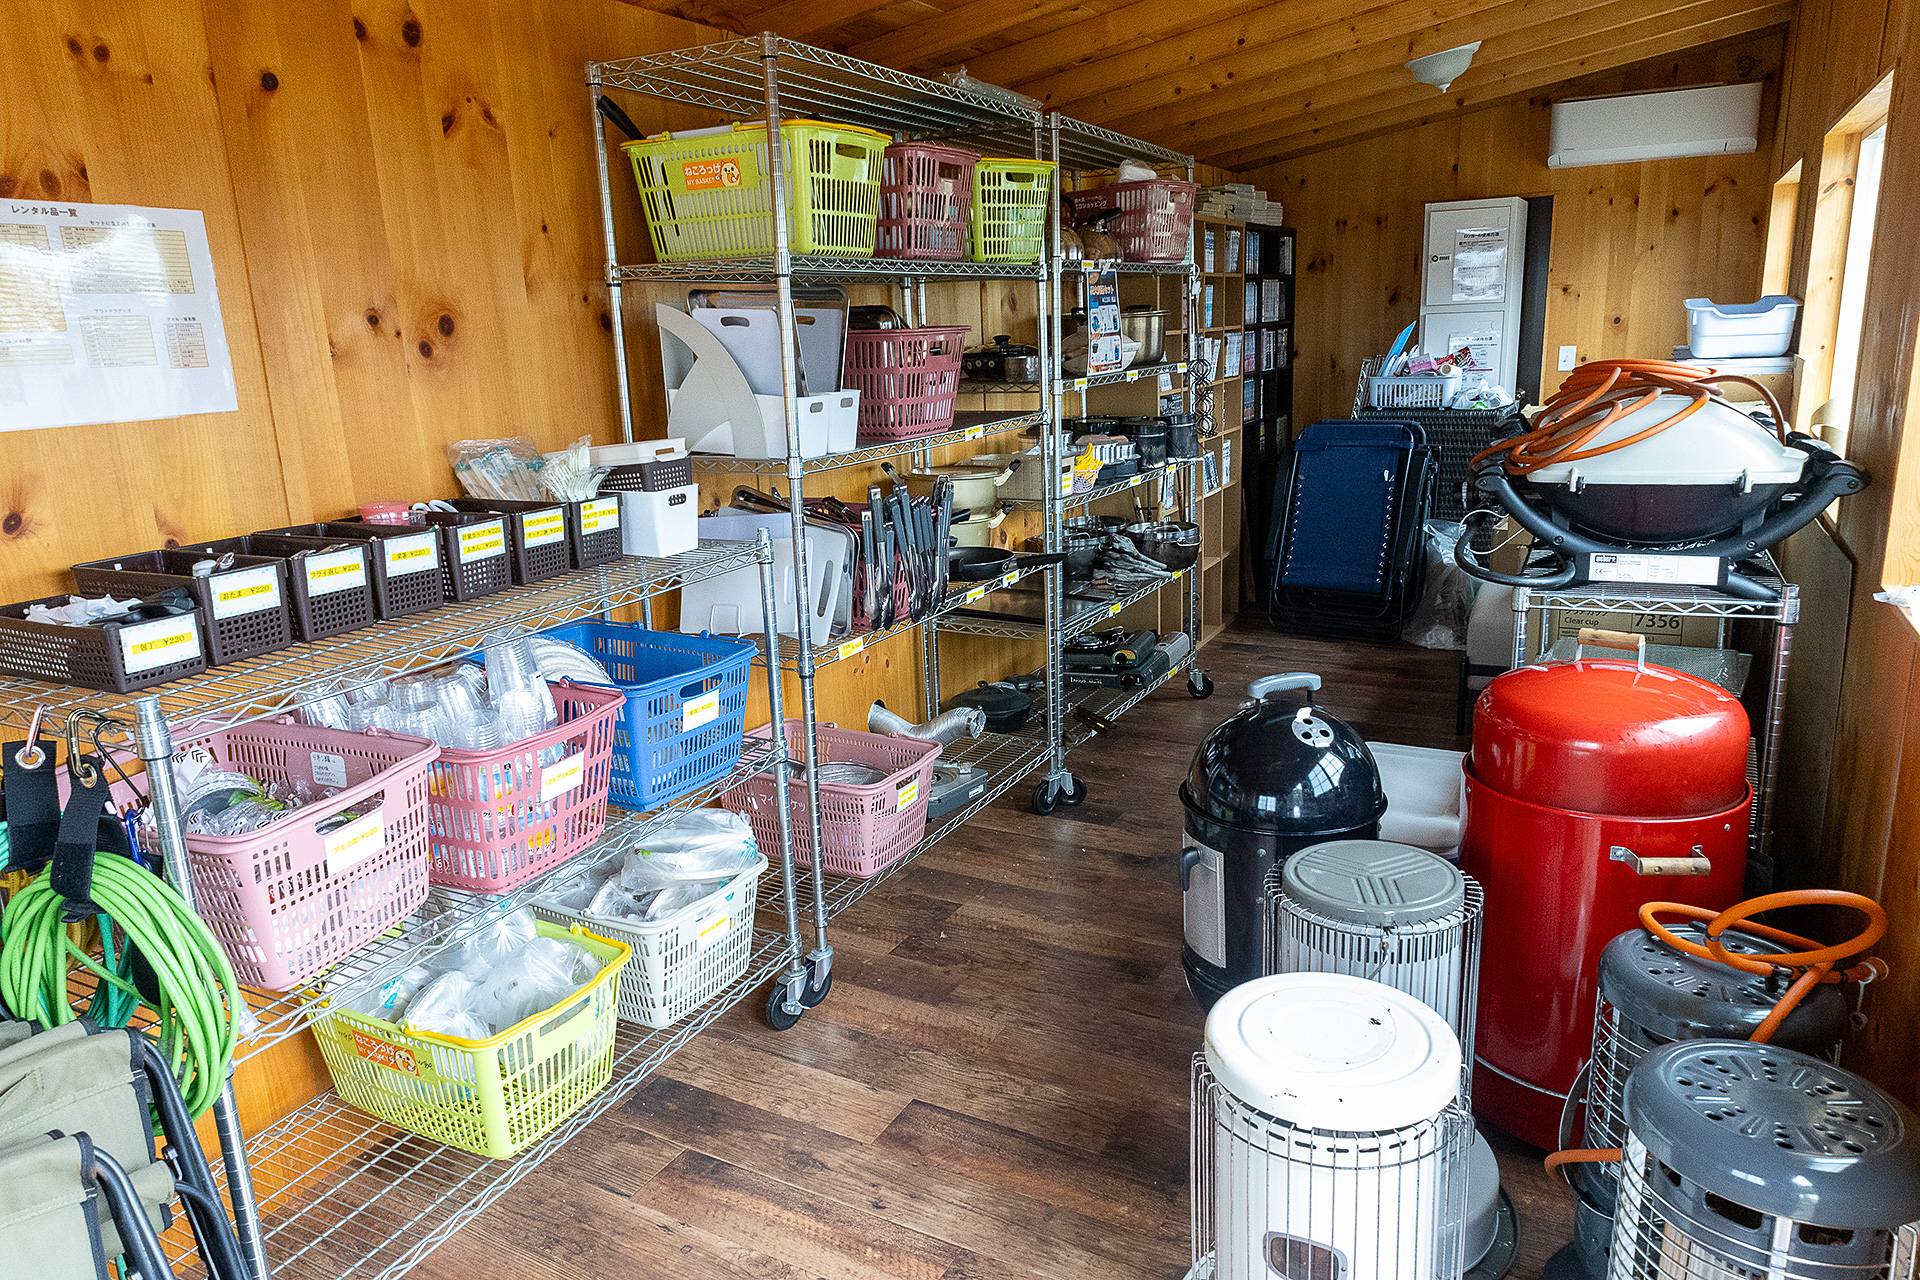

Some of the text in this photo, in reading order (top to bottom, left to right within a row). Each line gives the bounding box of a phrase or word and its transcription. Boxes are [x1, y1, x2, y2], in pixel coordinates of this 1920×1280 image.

[685, 163, 720, 176] ねころっけ
[695, 177, 715, 185] BASKET
[11, 205, 78, 217] レンタル品一覧
[410, 549, 426, 557] ¥220
[343, 563, 360, 572] ¥220
[223, 584, 270, 601] おたま ¥220
[1564, 616, 1600, 627] Clear cup
[1634, 612, 1680, 630] 7356
[163, 634, 185, 646] ¥220
[354, 1033, 395, 1056] ねころっけ
